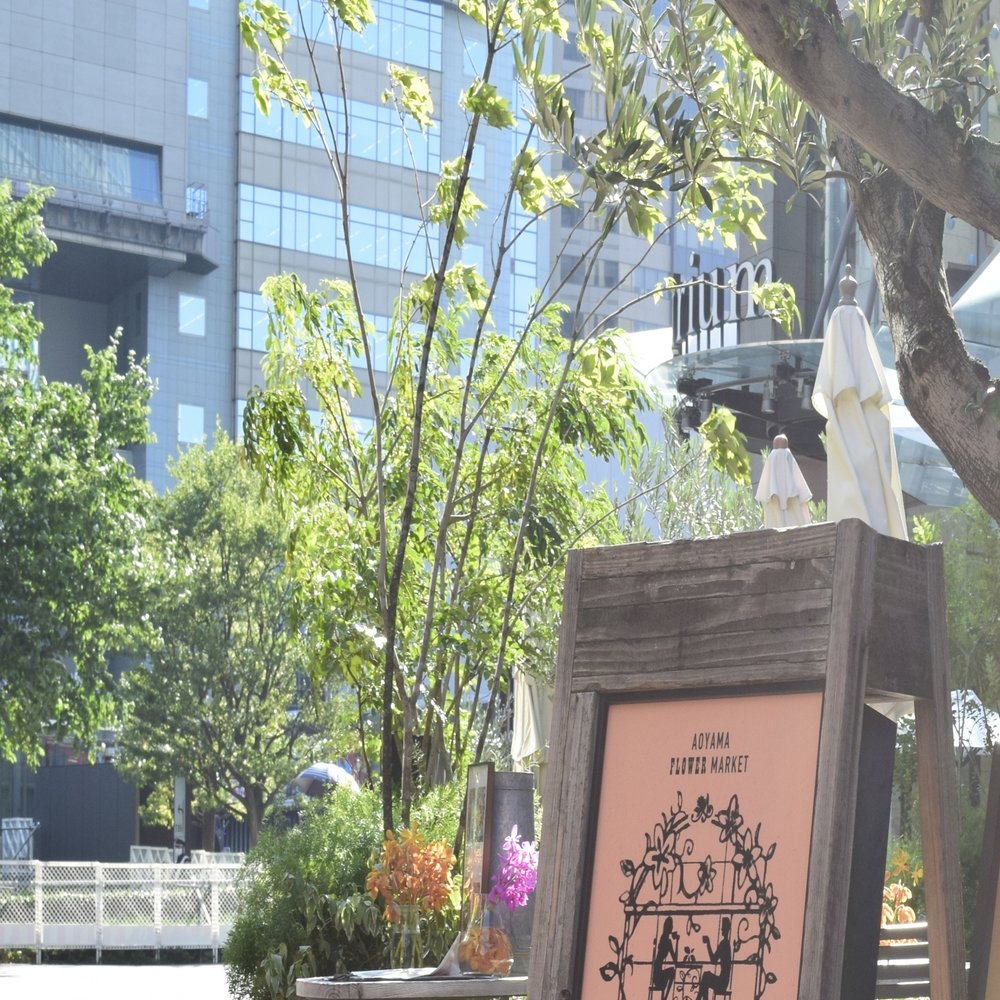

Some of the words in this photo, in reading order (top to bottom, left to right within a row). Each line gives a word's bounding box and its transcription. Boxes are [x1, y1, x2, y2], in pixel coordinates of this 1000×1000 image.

[691, 731, 731, 751] AOYAMA
[669, 756, 707, 775] FLOWER
[710, 755, 749, 774] MARKET
